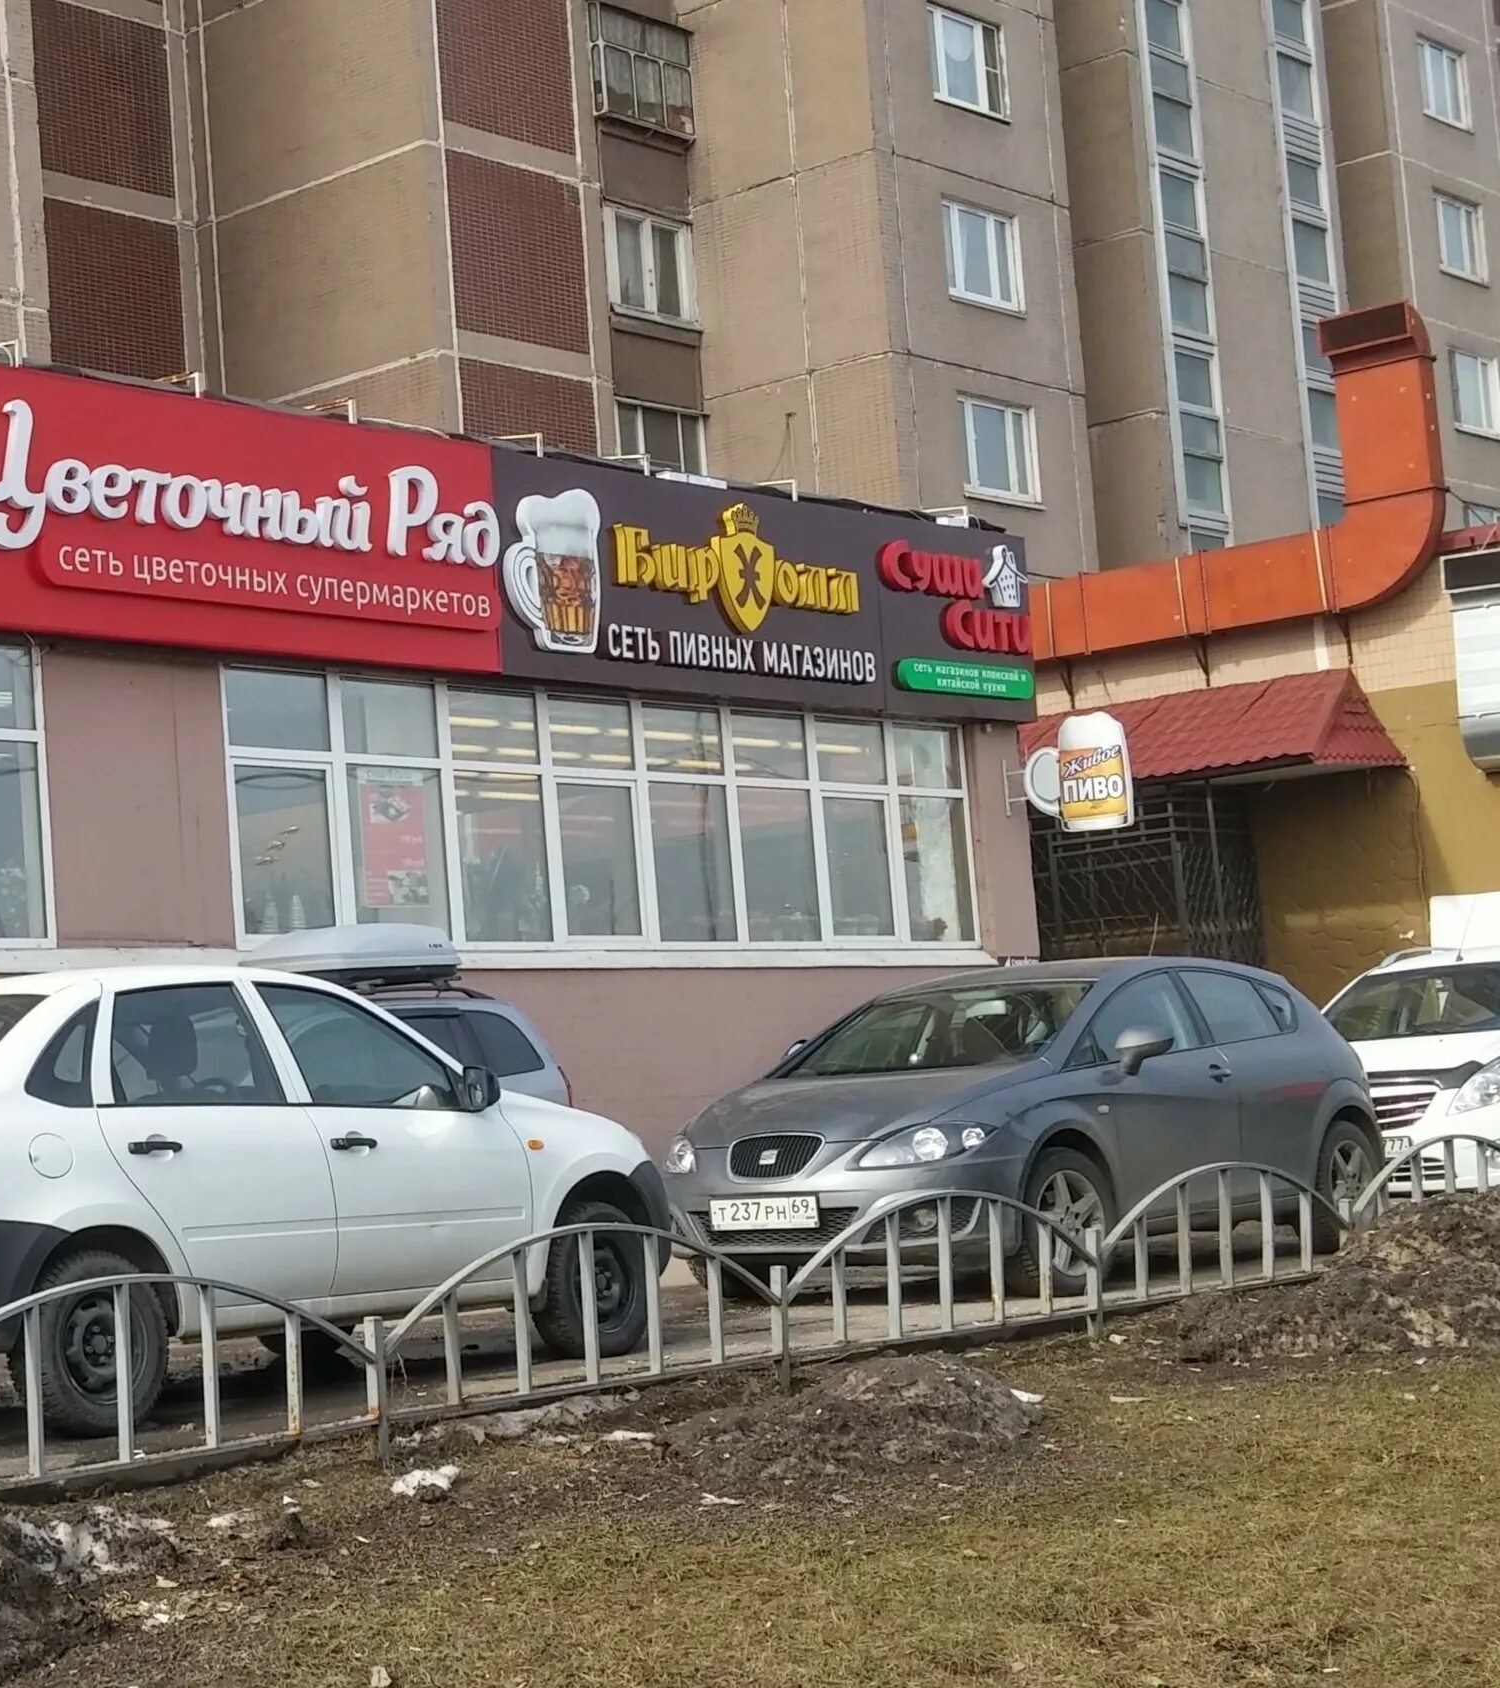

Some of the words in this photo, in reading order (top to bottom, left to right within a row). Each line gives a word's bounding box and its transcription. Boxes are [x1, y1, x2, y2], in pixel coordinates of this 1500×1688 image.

[387, 465, 500, 569] Ряд
[59, 544, 123, 577] сеть
[134, 552, 287, 597] цветочных
[297, 571, 490, 620] супермаркетов
[877, 539, 984, 600] Суши
[607, 622, 660, 662] СЕТЬ
[669, 630, 756, 673] ПИВНЫХ
[762, 641, 877, 683] МАГАЗИНОВ
[940, 599, 1033, 655] Сити
[913, 662, 932, 675] сеть
[935, 664, 979, 678] магазинов
[1062, 774, 1124, 804] ПИВО
[1063, 745, 1121, 777] Живое
[792, 1199, 809, 1214] 69
